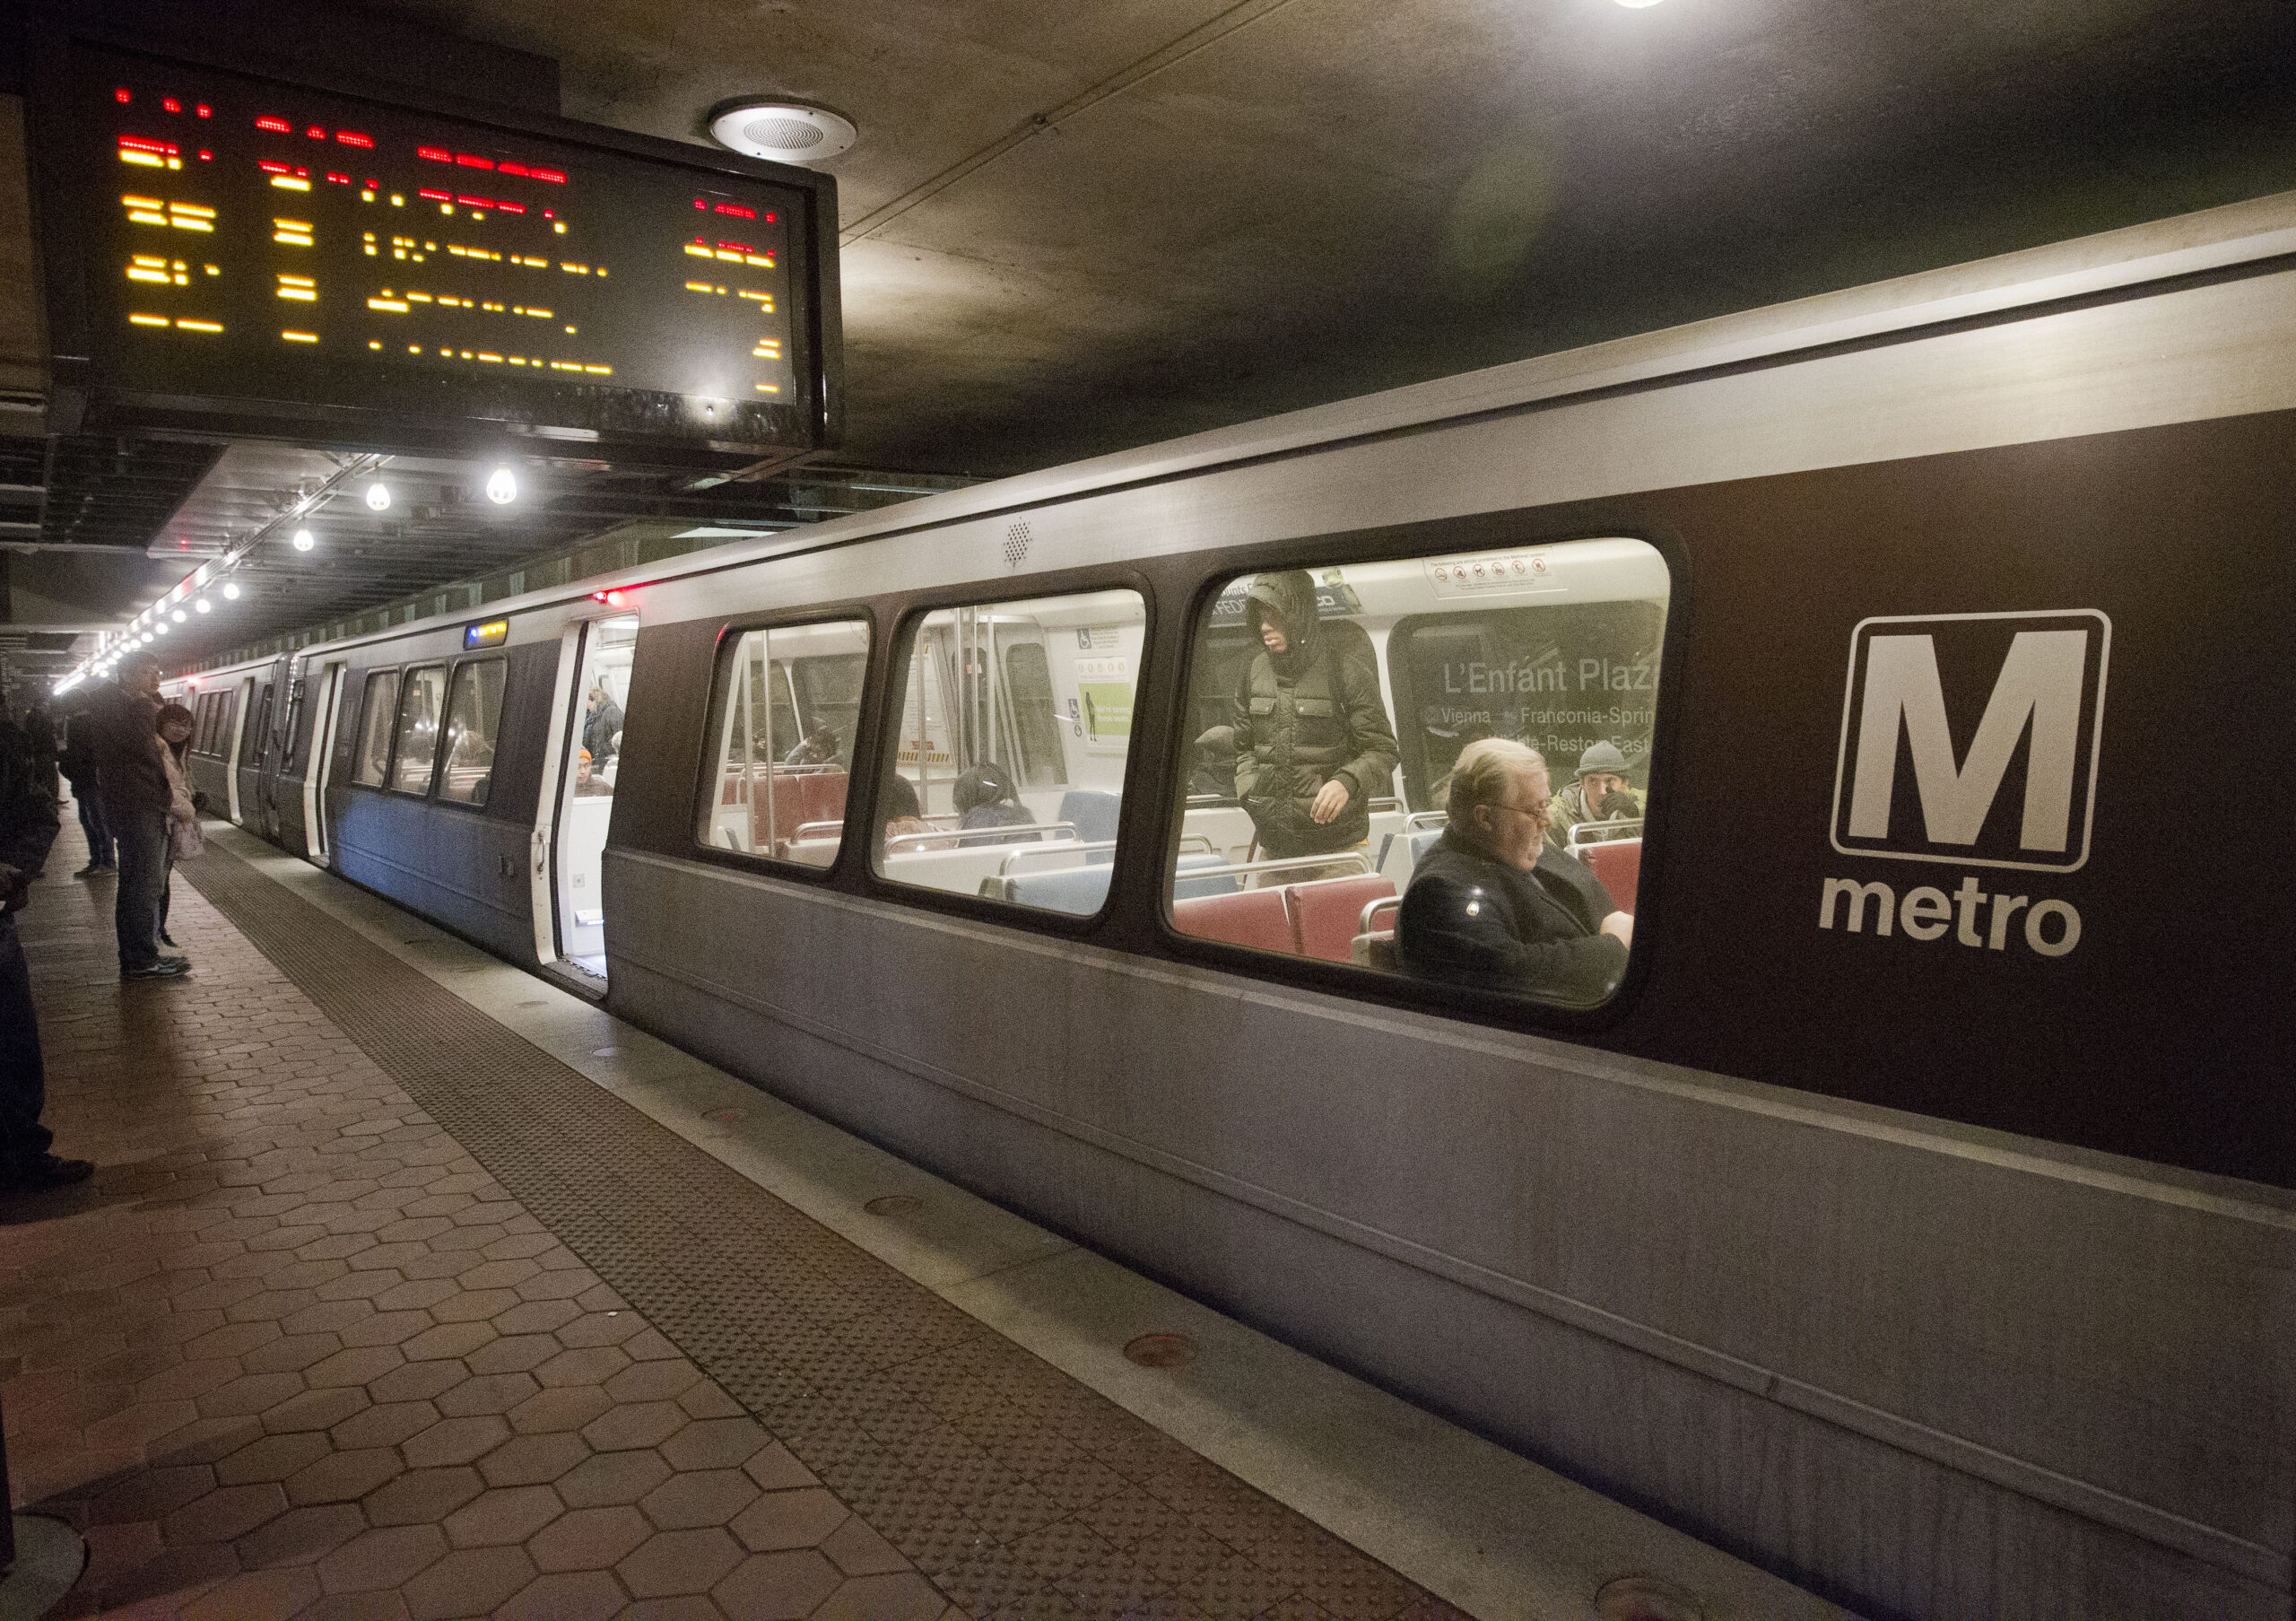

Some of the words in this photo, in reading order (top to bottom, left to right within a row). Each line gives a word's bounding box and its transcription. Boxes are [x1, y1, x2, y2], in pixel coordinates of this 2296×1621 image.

[1578, 658, 1653, 691] Plaz
[1441, 707, 1492, 724] Vienna
[1520, 706, 1655, 726] Franconia-Sprin
[1848, 630, 2089, 852] M
[1819, 876, 2083, 957] metro
